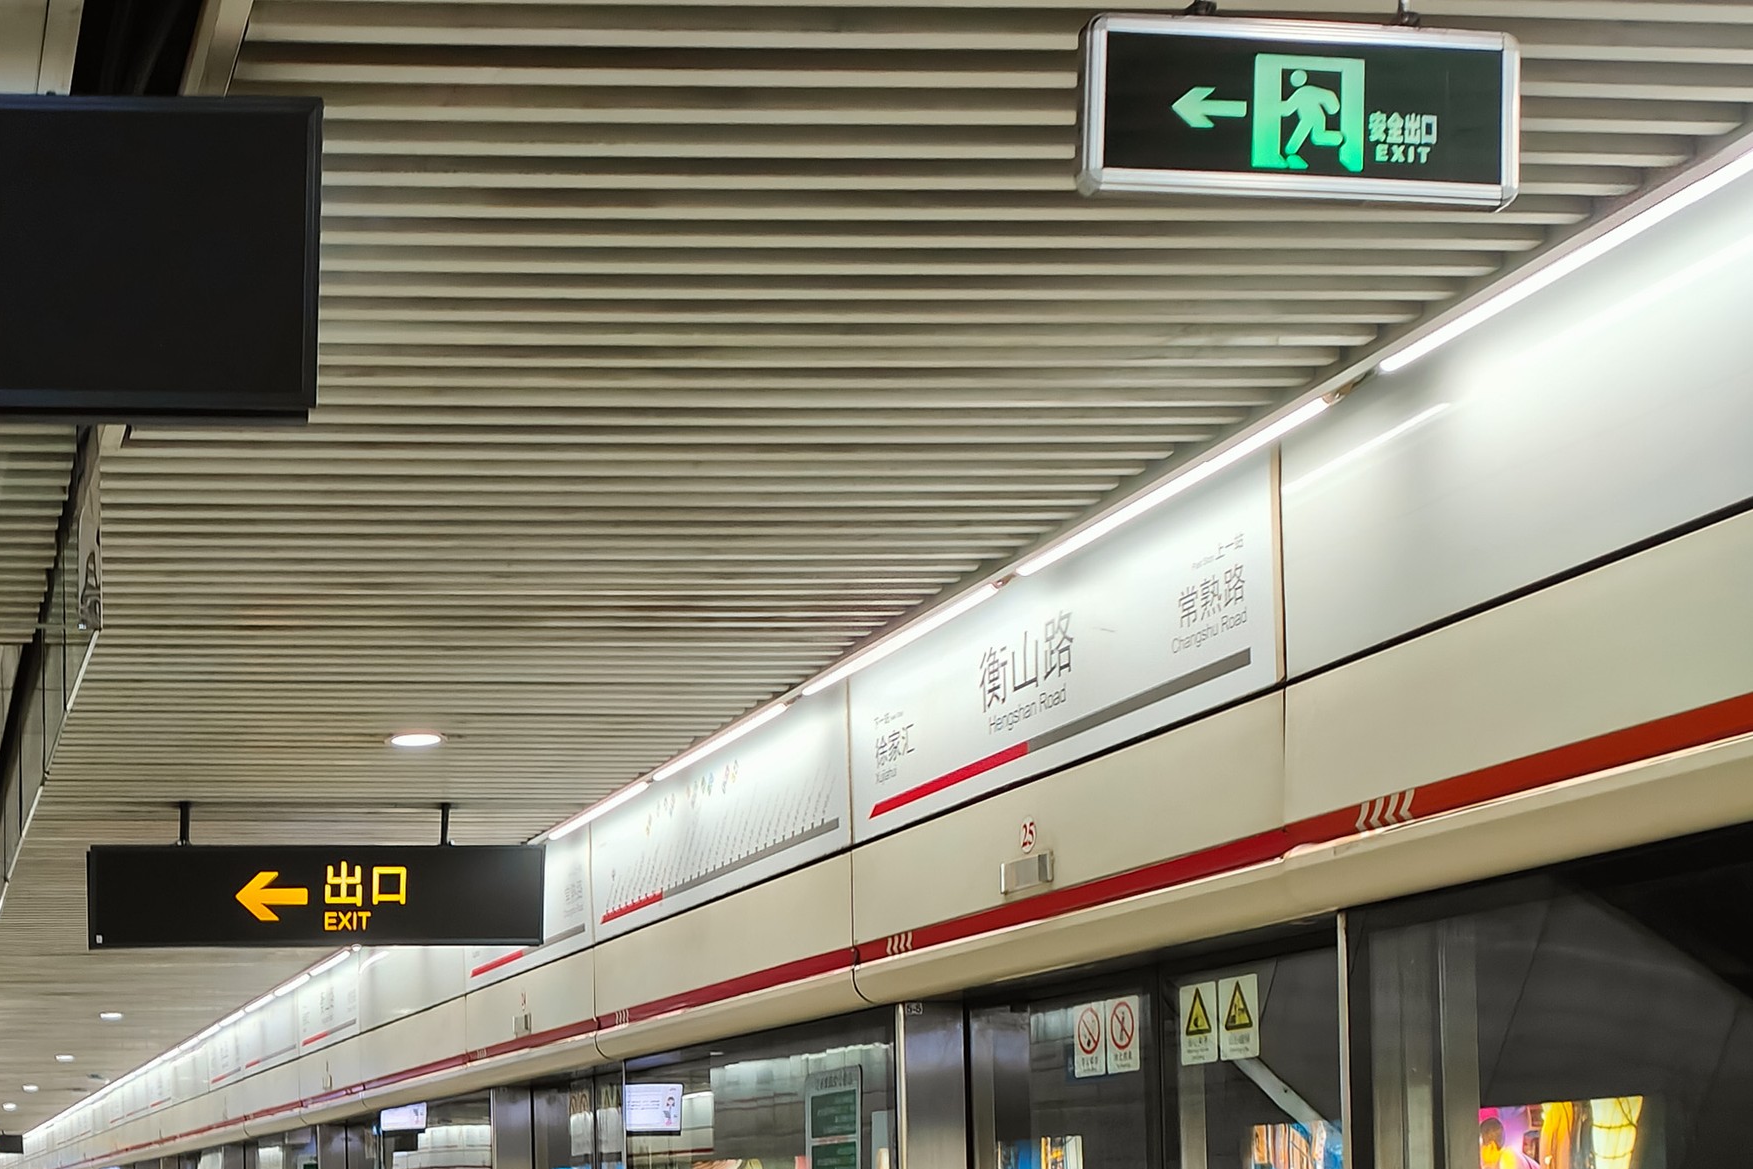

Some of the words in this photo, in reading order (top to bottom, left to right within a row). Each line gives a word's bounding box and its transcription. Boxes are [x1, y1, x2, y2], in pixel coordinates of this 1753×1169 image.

[1368, 110, 1437, 145] 安全出口
[1375, 143, 1431, 164] EXIT
[1178, 563, 1245, 628] 常熟路
[1171, 623, 1219, 654] Changshu
[1220, 605, 1248, 632] Road
[979, 609, 1074, 714] 衡山路
[988, 701, 1037, 735] Hengshan
[1039, 683, 1067, 713] Road
[875, 722, 915, 769] 徐家汇
[1021, 821, 1035, 848] 25
[325, 860, 407, 907] 出口
[324, 911, 372, 931] EXIT
